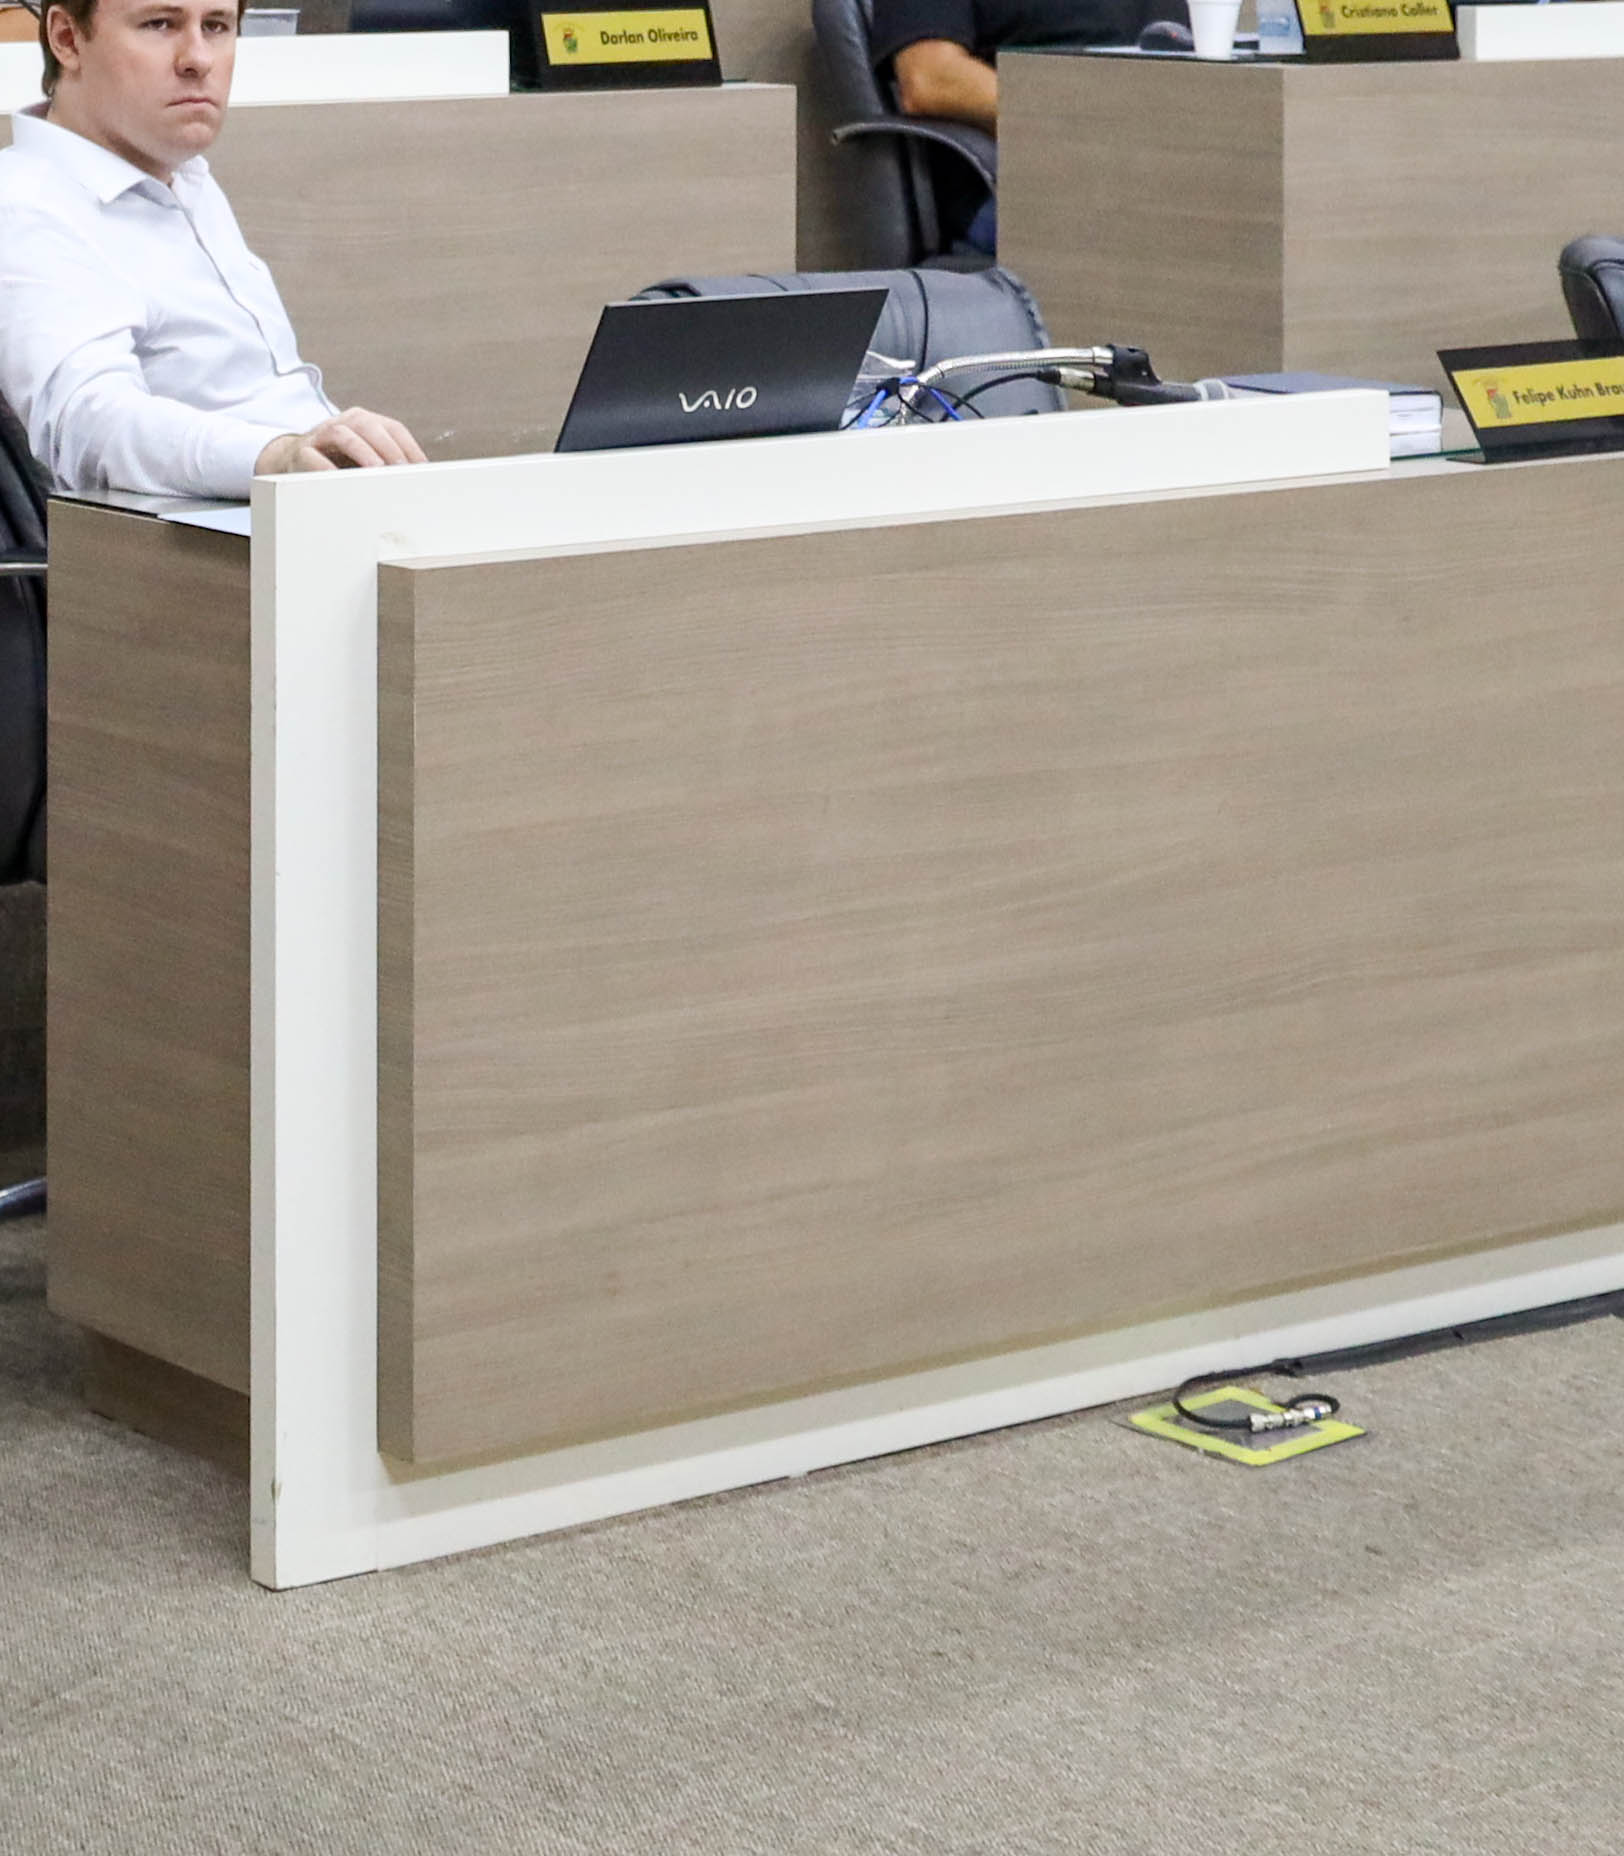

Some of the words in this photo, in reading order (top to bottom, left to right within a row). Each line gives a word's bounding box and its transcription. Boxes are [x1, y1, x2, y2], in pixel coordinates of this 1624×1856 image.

[600, 30, 644, 46] Darlan
[648, 27, 699, 43] Oliveira
[678, 386, 758, 413] VAIO
[1512, 387, 1556, 407] Felipe
[1558, 385, 1594, 401] Kuhn
